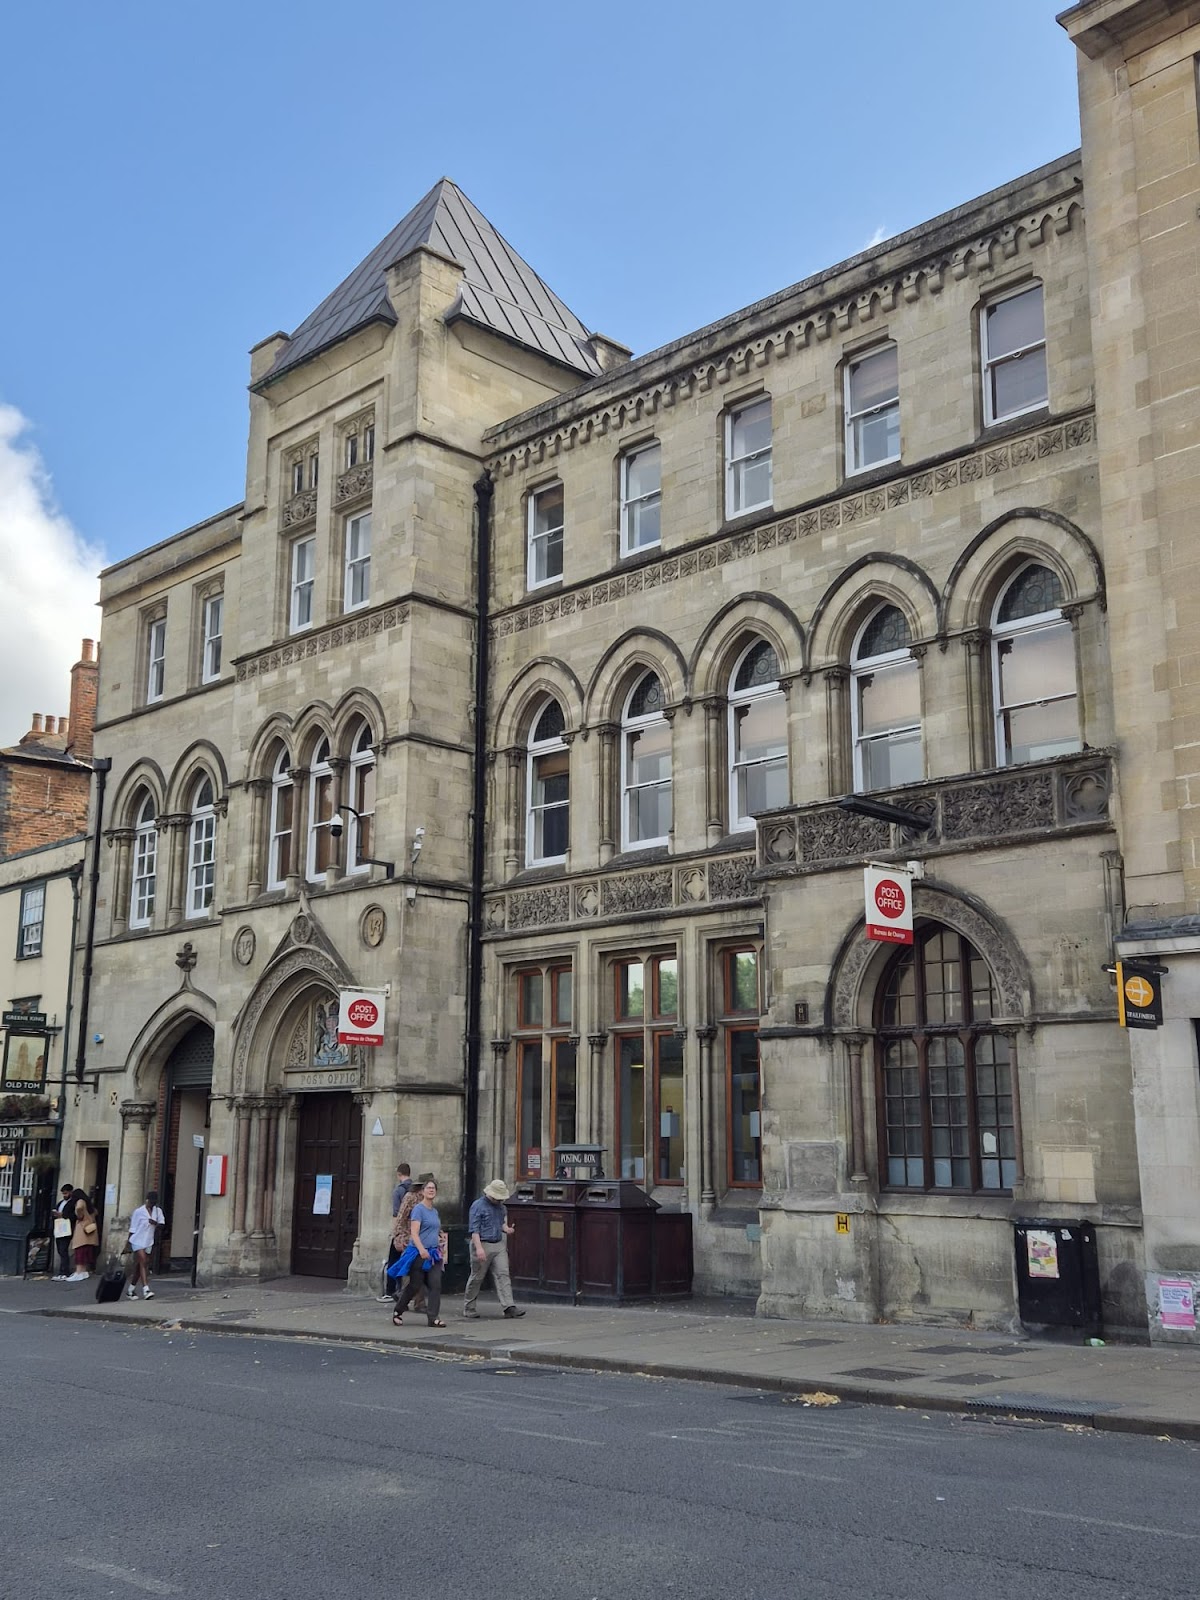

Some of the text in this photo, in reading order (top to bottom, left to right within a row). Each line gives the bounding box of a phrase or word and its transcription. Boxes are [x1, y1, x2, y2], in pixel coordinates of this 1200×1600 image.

[882, 887, 899, 898] POST
[878, 898, 902, 910] OFFICE
[893, 931, 905, 939] Change
[355, 1005, 372, 1013] POST
[351, 1013, 375, 1021] OFFICE
[1127, 1011, 1155, 1020] TRAILFINDERS
[300, 1072, 357, 1085] POST OFFIC
[10, 1128, 23, 1137] TOM
[561, 1153, 595, 1163] POSTING BOX
